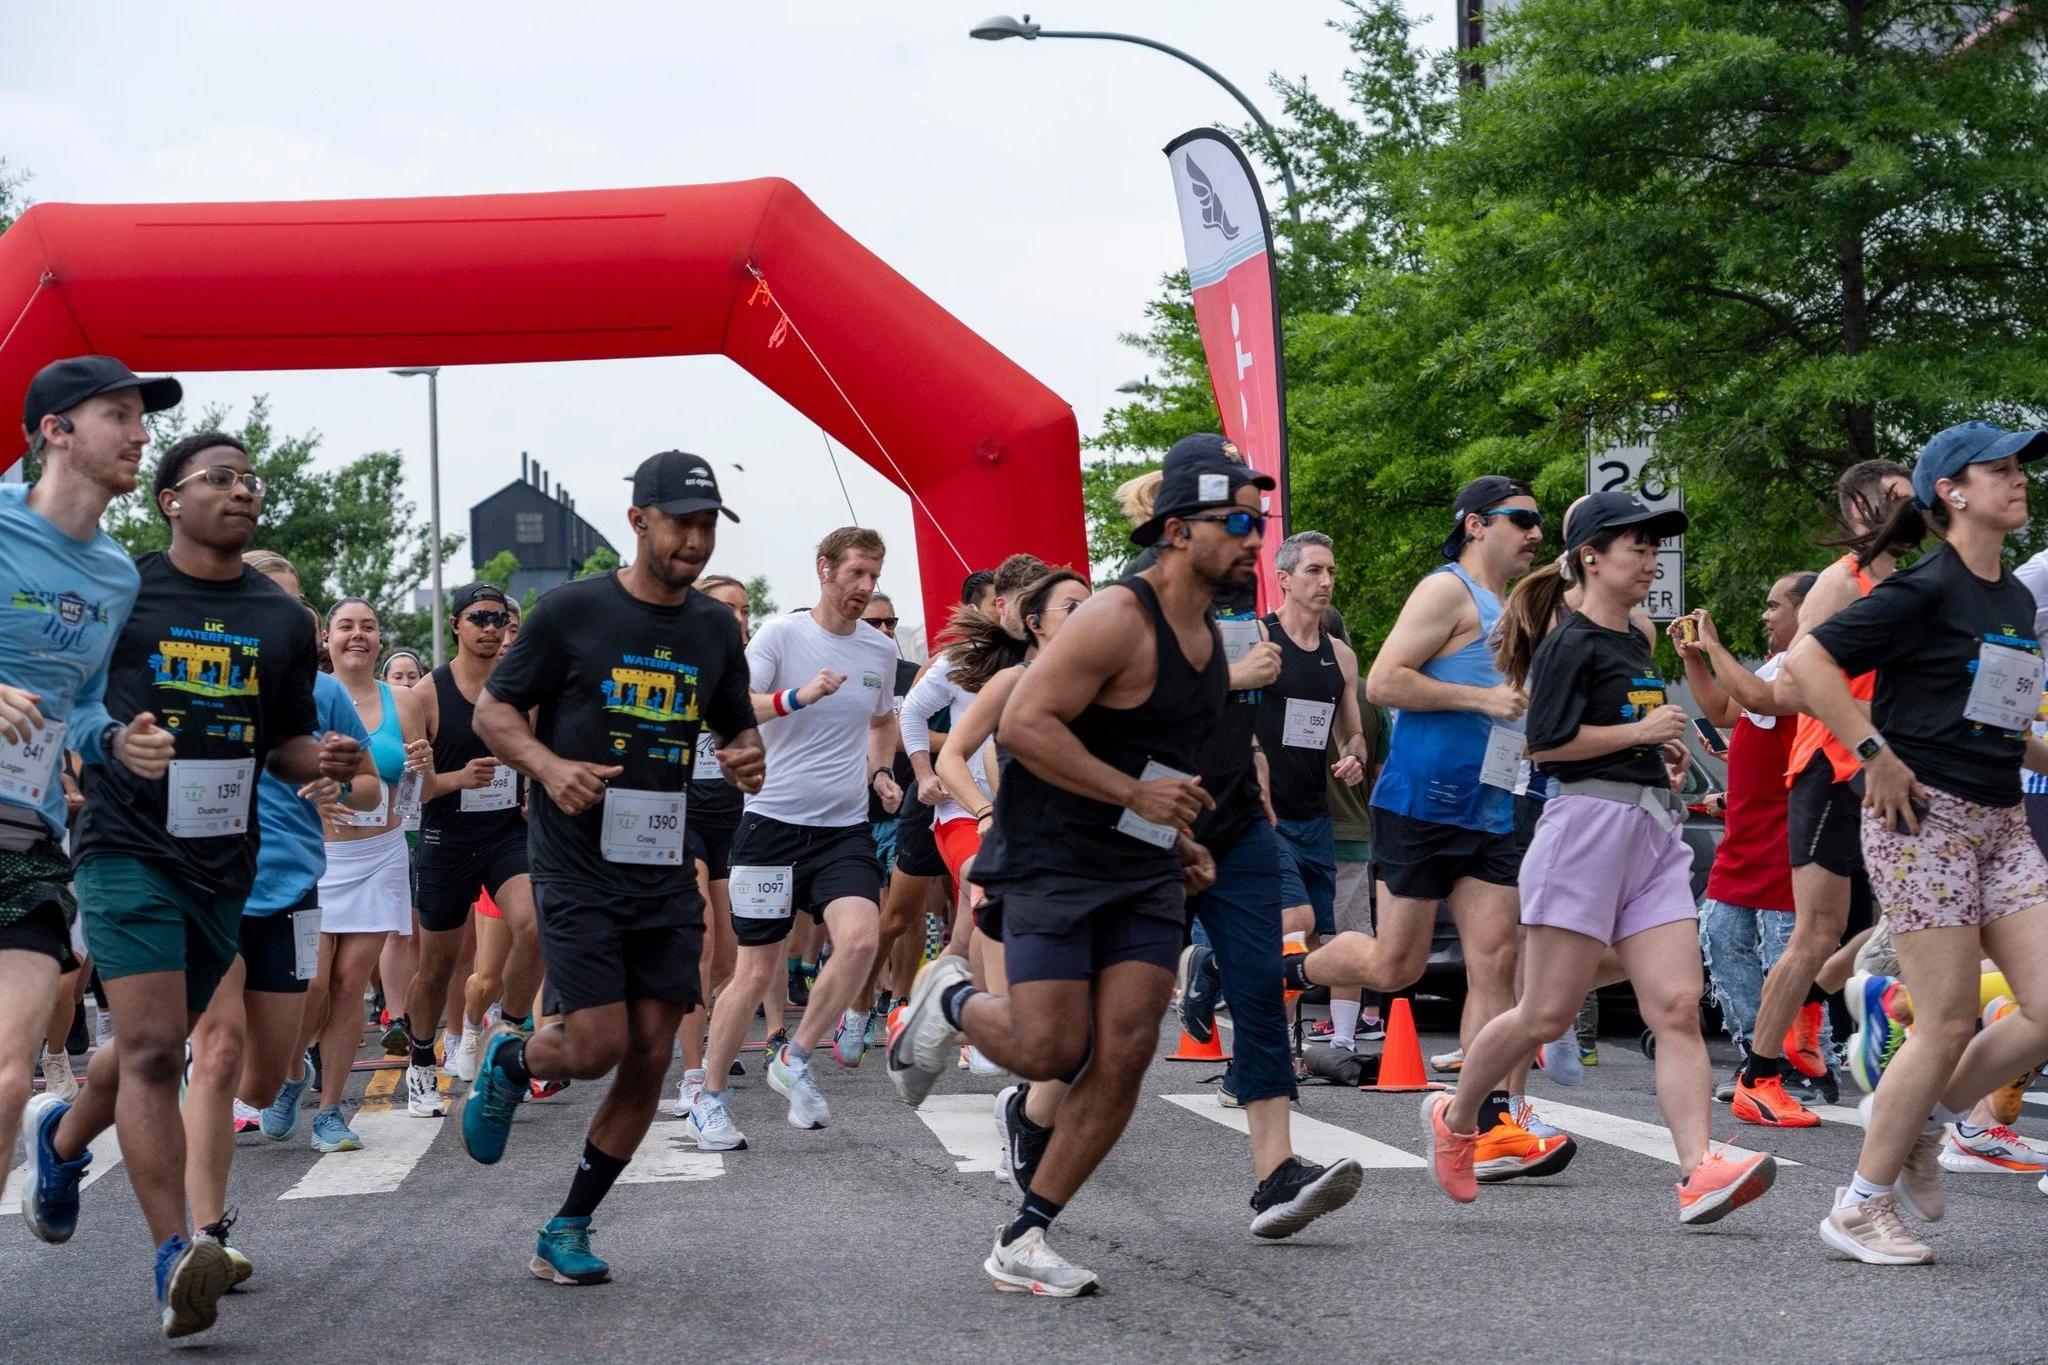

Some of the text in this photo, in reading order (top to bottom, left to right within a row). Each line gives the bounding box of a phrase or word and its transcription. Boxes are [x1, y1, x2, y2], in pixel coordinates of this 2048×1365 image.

[61, 600, 81, 613] NYC
[204, 622, 225, 633] LIC
[170, 626, 261, 647] WATERFRONT
[241, 646, 260, 657] 5K
[654, 648, 673, 660] LIC
[623, 654, 700, 676] WATERFRONT
[684, 674, 698, 685] 5K
[2015, 677, 2035, 695] 591
[1310, 716, 1326, 727] 1350
[23, 742, 45, 761] 641
[217, 782, 241, 799] 1391
[648, 814, 678, 830] 1390
[636, 834, 657, 846] Craig
[758, 882, 784, 893] 1097
